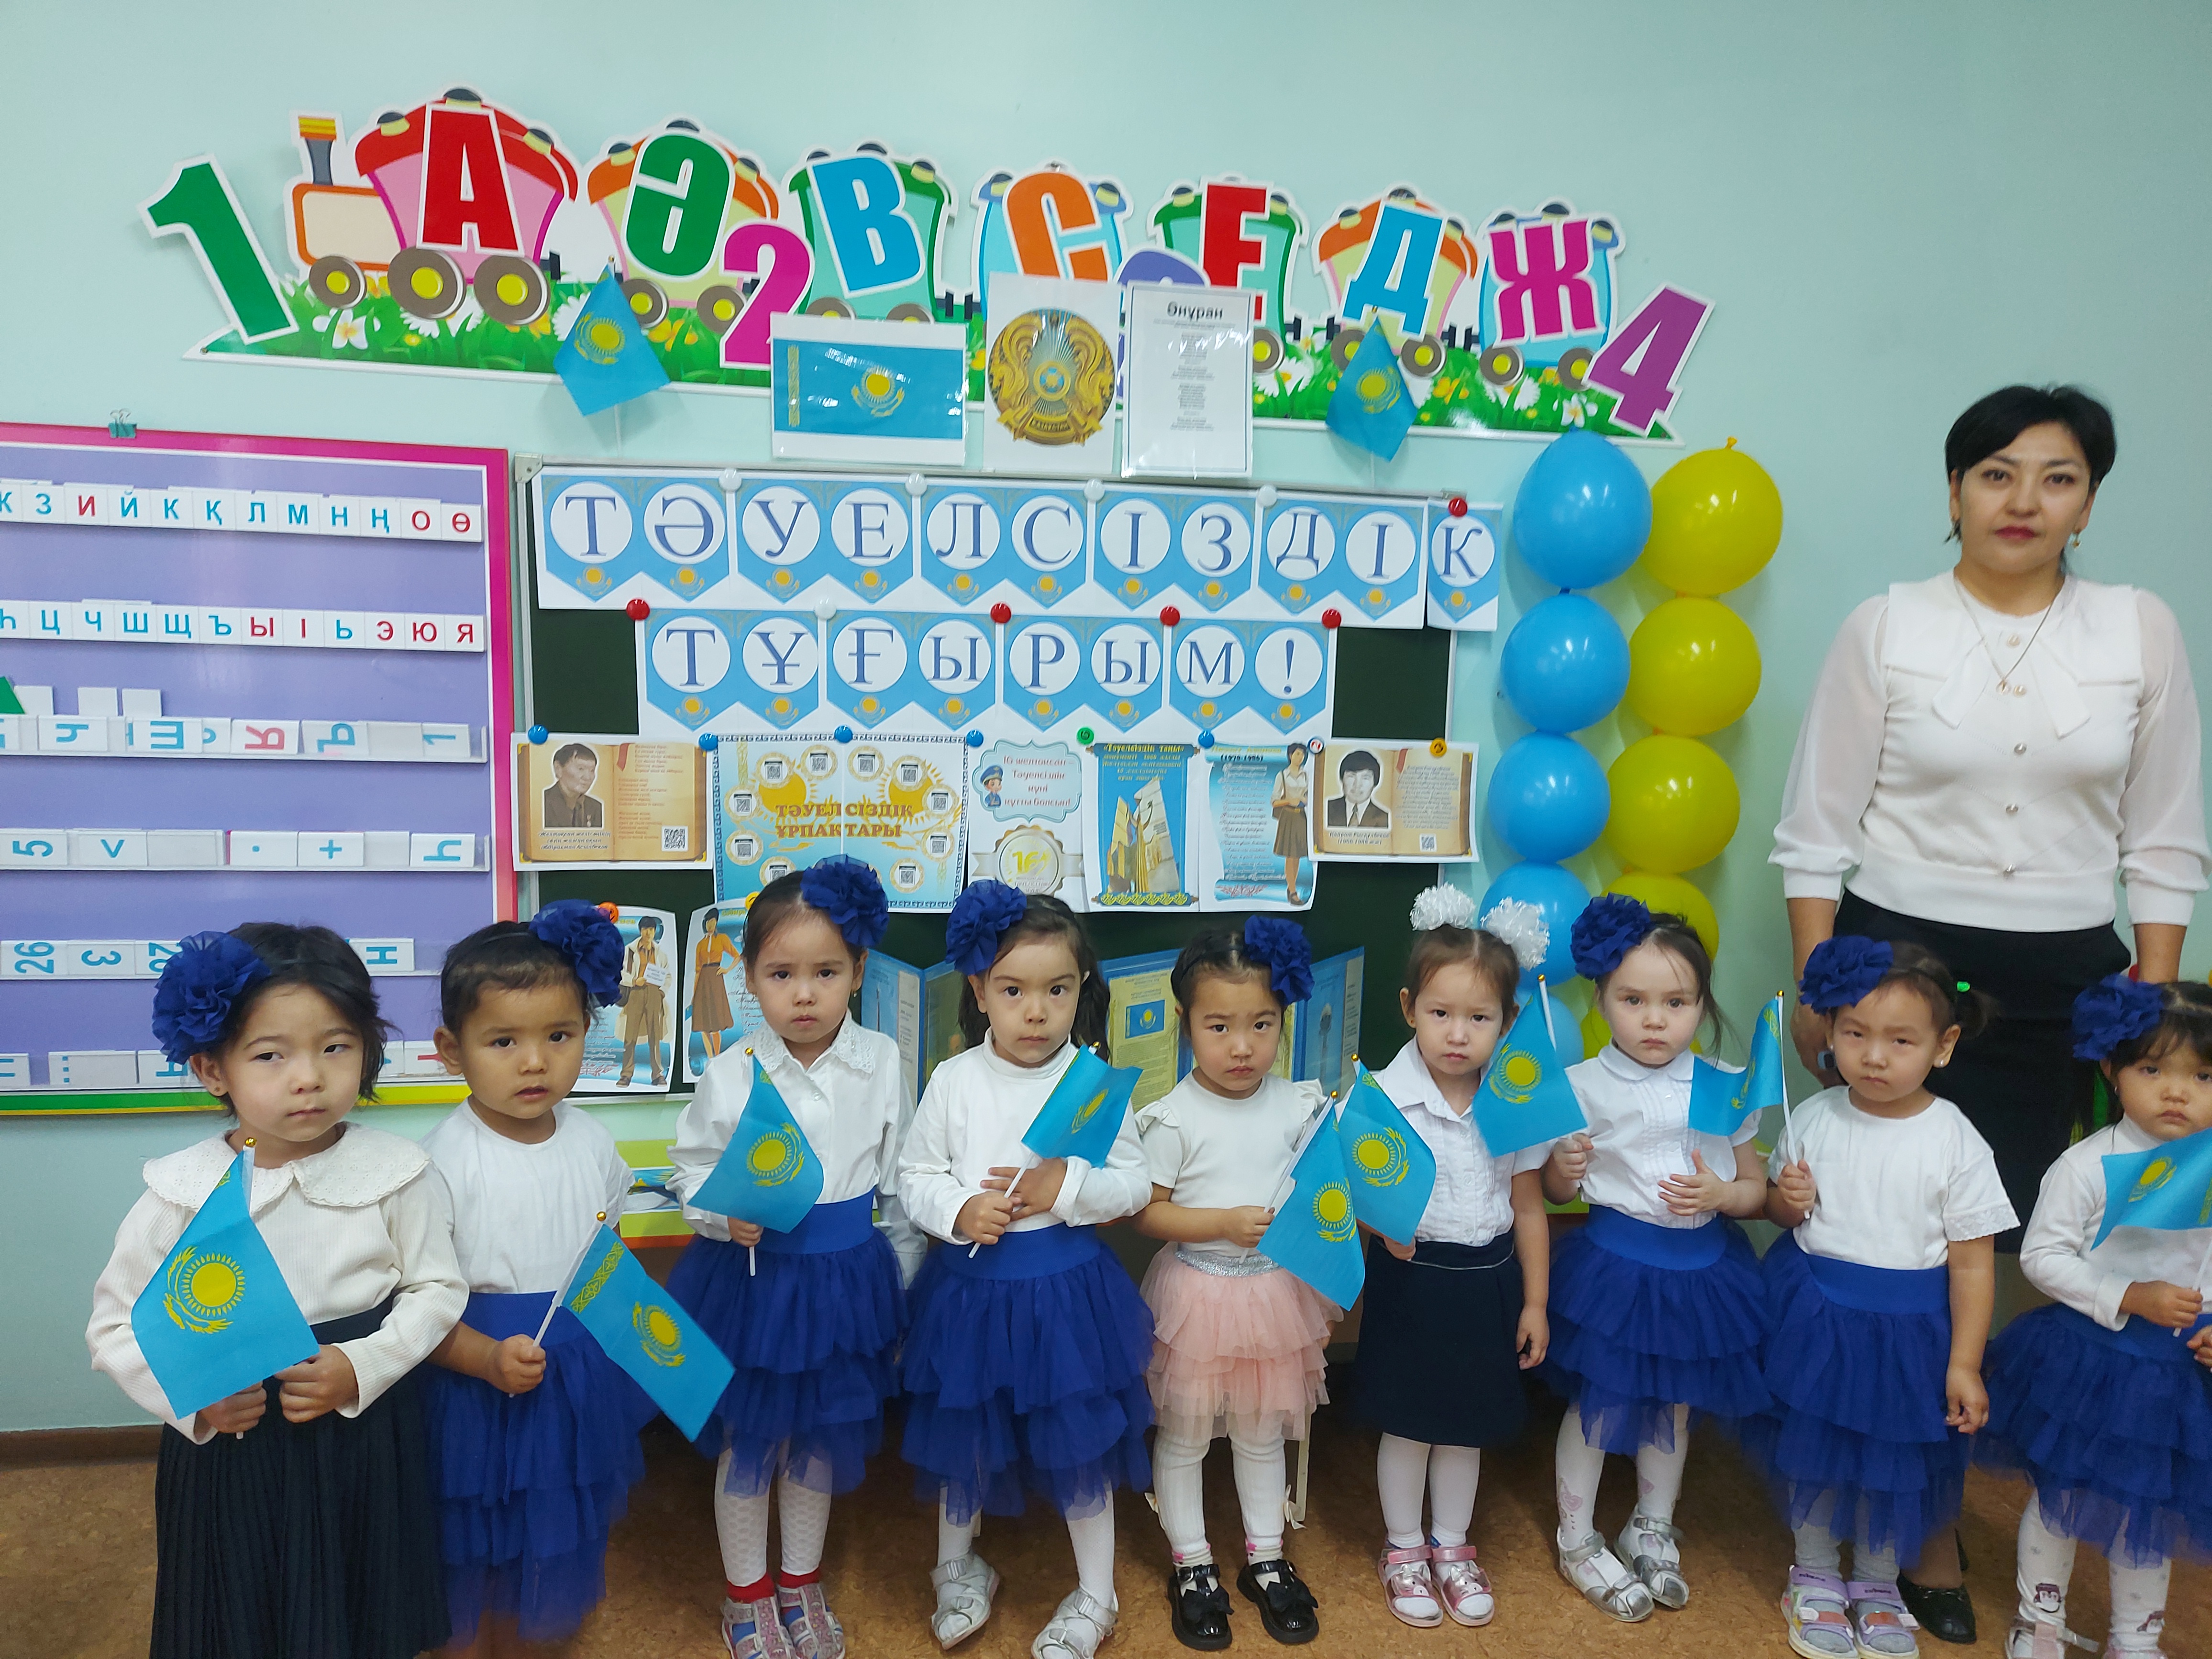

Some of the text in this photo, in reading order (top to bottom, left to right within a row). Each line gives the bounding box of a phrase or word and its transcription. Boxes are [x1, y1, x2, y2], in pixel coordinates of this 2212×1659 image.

[1342, 204, 1443, 337] Д
[1489, 220, 1597, 341] Ж
[1588, 286, 1708, 430] 4
[41, 609, 60, 635] Ц
[123, 612, 148, 633] Ш
[164, 613, 192, 638] Щ
[208, 615, 232, 635] Ъ
[251, 617, 274, 637] Ы
[377, 621, 393, 641] Э
[413, 622, 437, 642] Ю
[457, 624, 473, 643] Я
